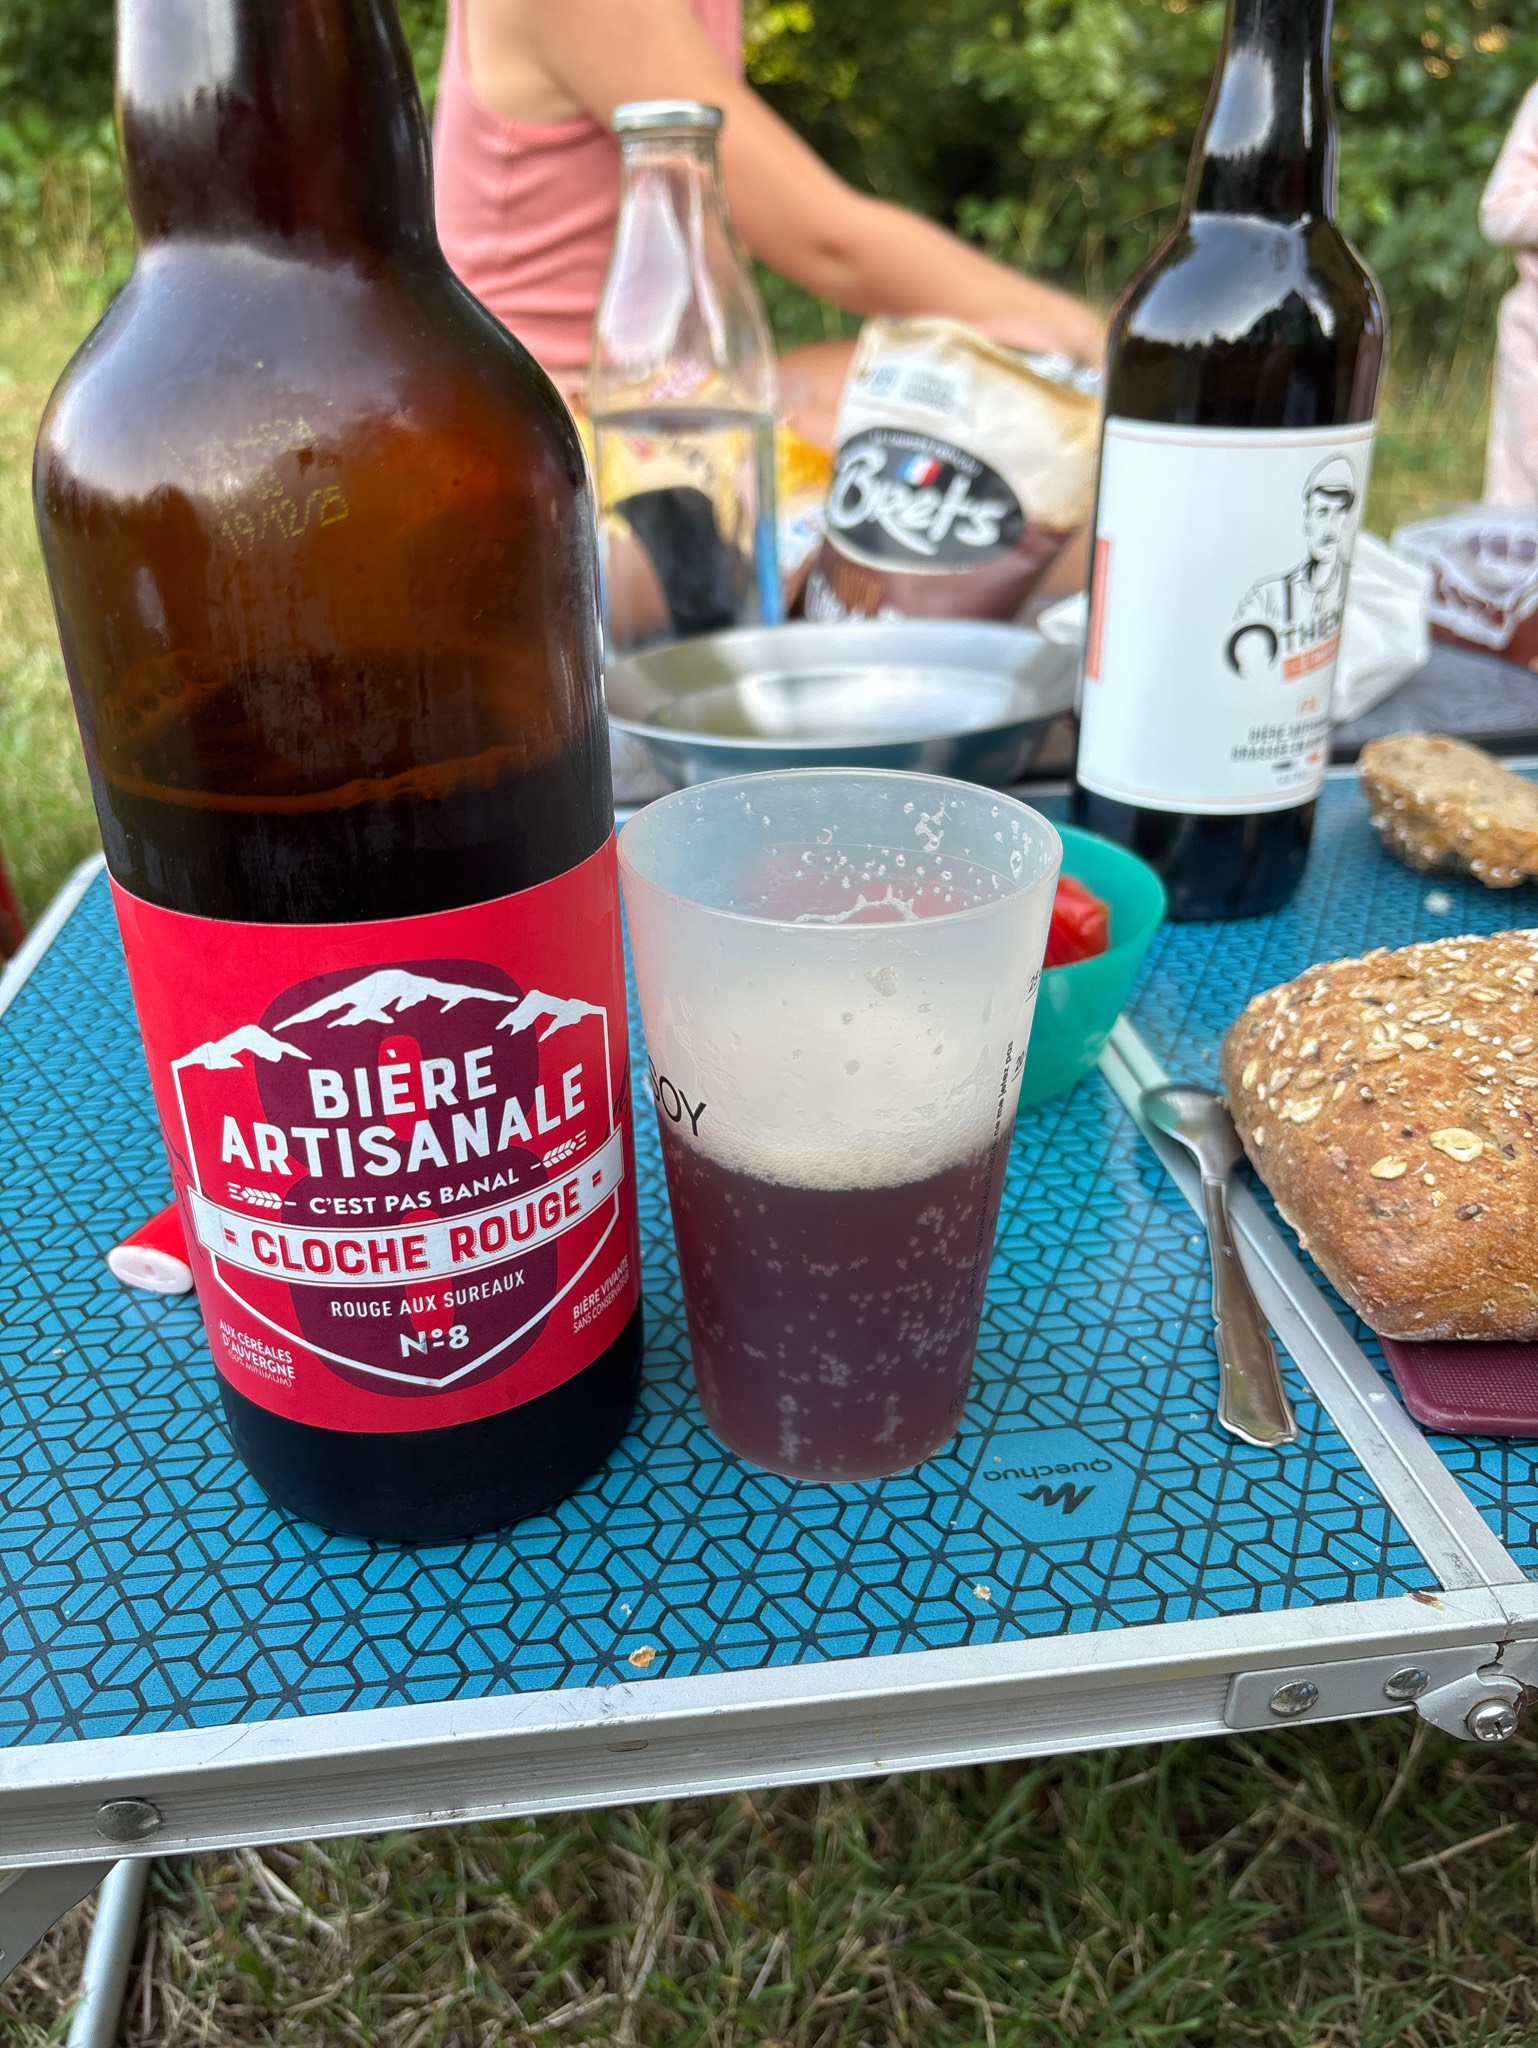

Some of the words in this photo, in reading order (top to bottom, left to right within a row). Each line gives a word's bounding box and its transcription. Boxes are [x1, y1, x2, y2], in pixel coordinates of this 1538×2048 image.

[308, 1045, 497, 1119] BIÈRE
[999, 1065, 1010, 1098] jetez
[1005, 1040, 1014, 1065] pas
[221, 1063, 586, 1178] ARTISANALE
[309, 1196, 377, 1215] C'EST
[385, 1190, 432, 1213] PAS
[440, 1167, 520, 1205] BANAL
[251, 1230, 434, 1277] CLOCHE
[449, 1177, 584, 1265] ROUGE
[330, 1299, 393, 1318] ROUGE
[399, 1294, 437, 1316] AUX
[444, 1269, 526, 1309] SUREAUX
[573, 1288, 601, 1320] BIÈRE
[600, 1253, 629, 1296] VIVANTE
[219, 1318, 237, 1341] AUX
[237, 1332, 293, 1364] CÉRÉALES
[573, 1311, 592, 1334] SANS
[982, 1457, 1113, 1482] Quechua
